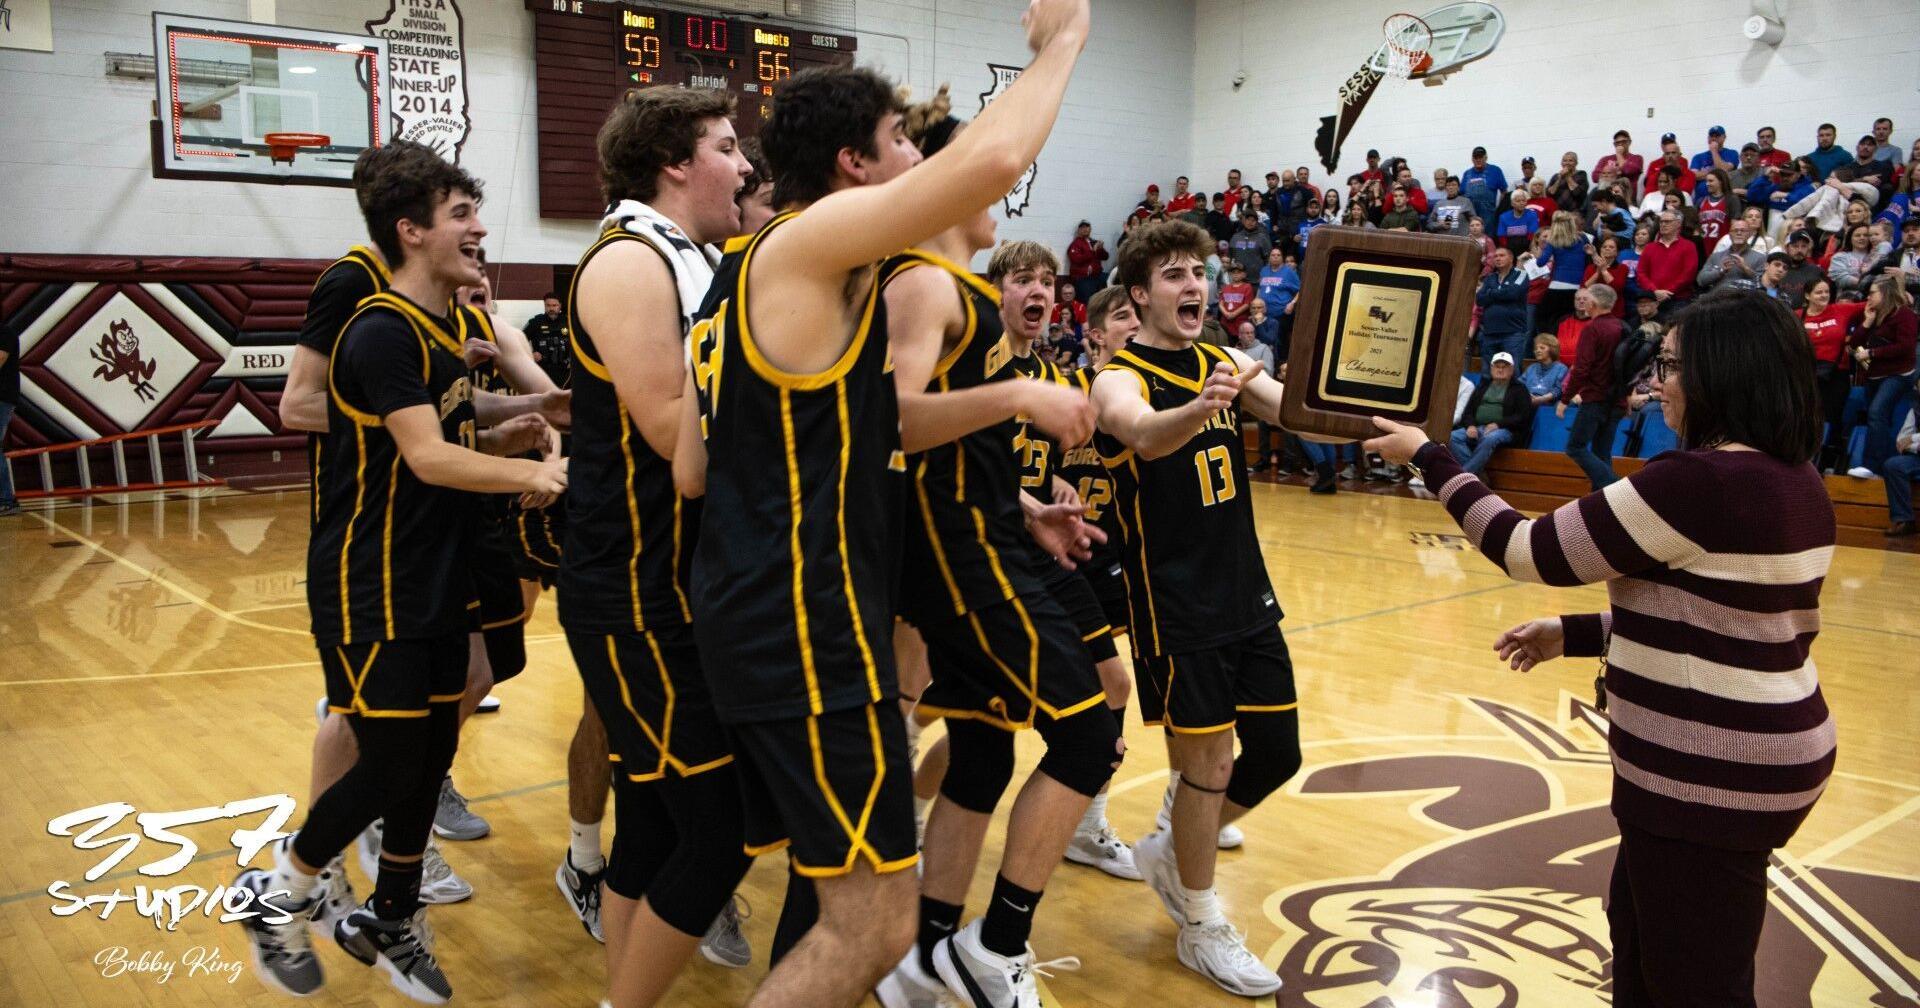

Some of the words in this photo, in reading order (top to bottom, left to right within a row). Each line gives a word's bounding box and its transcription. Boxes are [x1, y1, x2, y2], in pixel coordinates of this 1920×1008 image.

[409, 8, 439, 20] SMALL
[623, 10, 655, 29] Home
[403, 18, 446, 32] DIVISION
[381, 29, 453, 46] COMPETITIVE
[754, 29, 790, 47] Guests
[811, 34, 838, 48] GUESTS
[389, 43, 459, 60] EERLEADING
[625, 33, 660, 67] 59
[390, 57, 440, 75] STATE
[391, 74, 456, 93] NNER-UP
[1000, 70, 1019, 82] IHS
[400, 95, 452, 115] 2014
[405, 117, 464, 139] ESSER-VALIER
[427, 124, 453, 134] DEVILS
[1373, 333, 1408, 342] Tournament
[241, 353, 285, 369] RED
[1345, 360, 1402, 377] Champions
[1194, 445, 1236, 507] 13
[1078, 476, 1112, 521] 12
